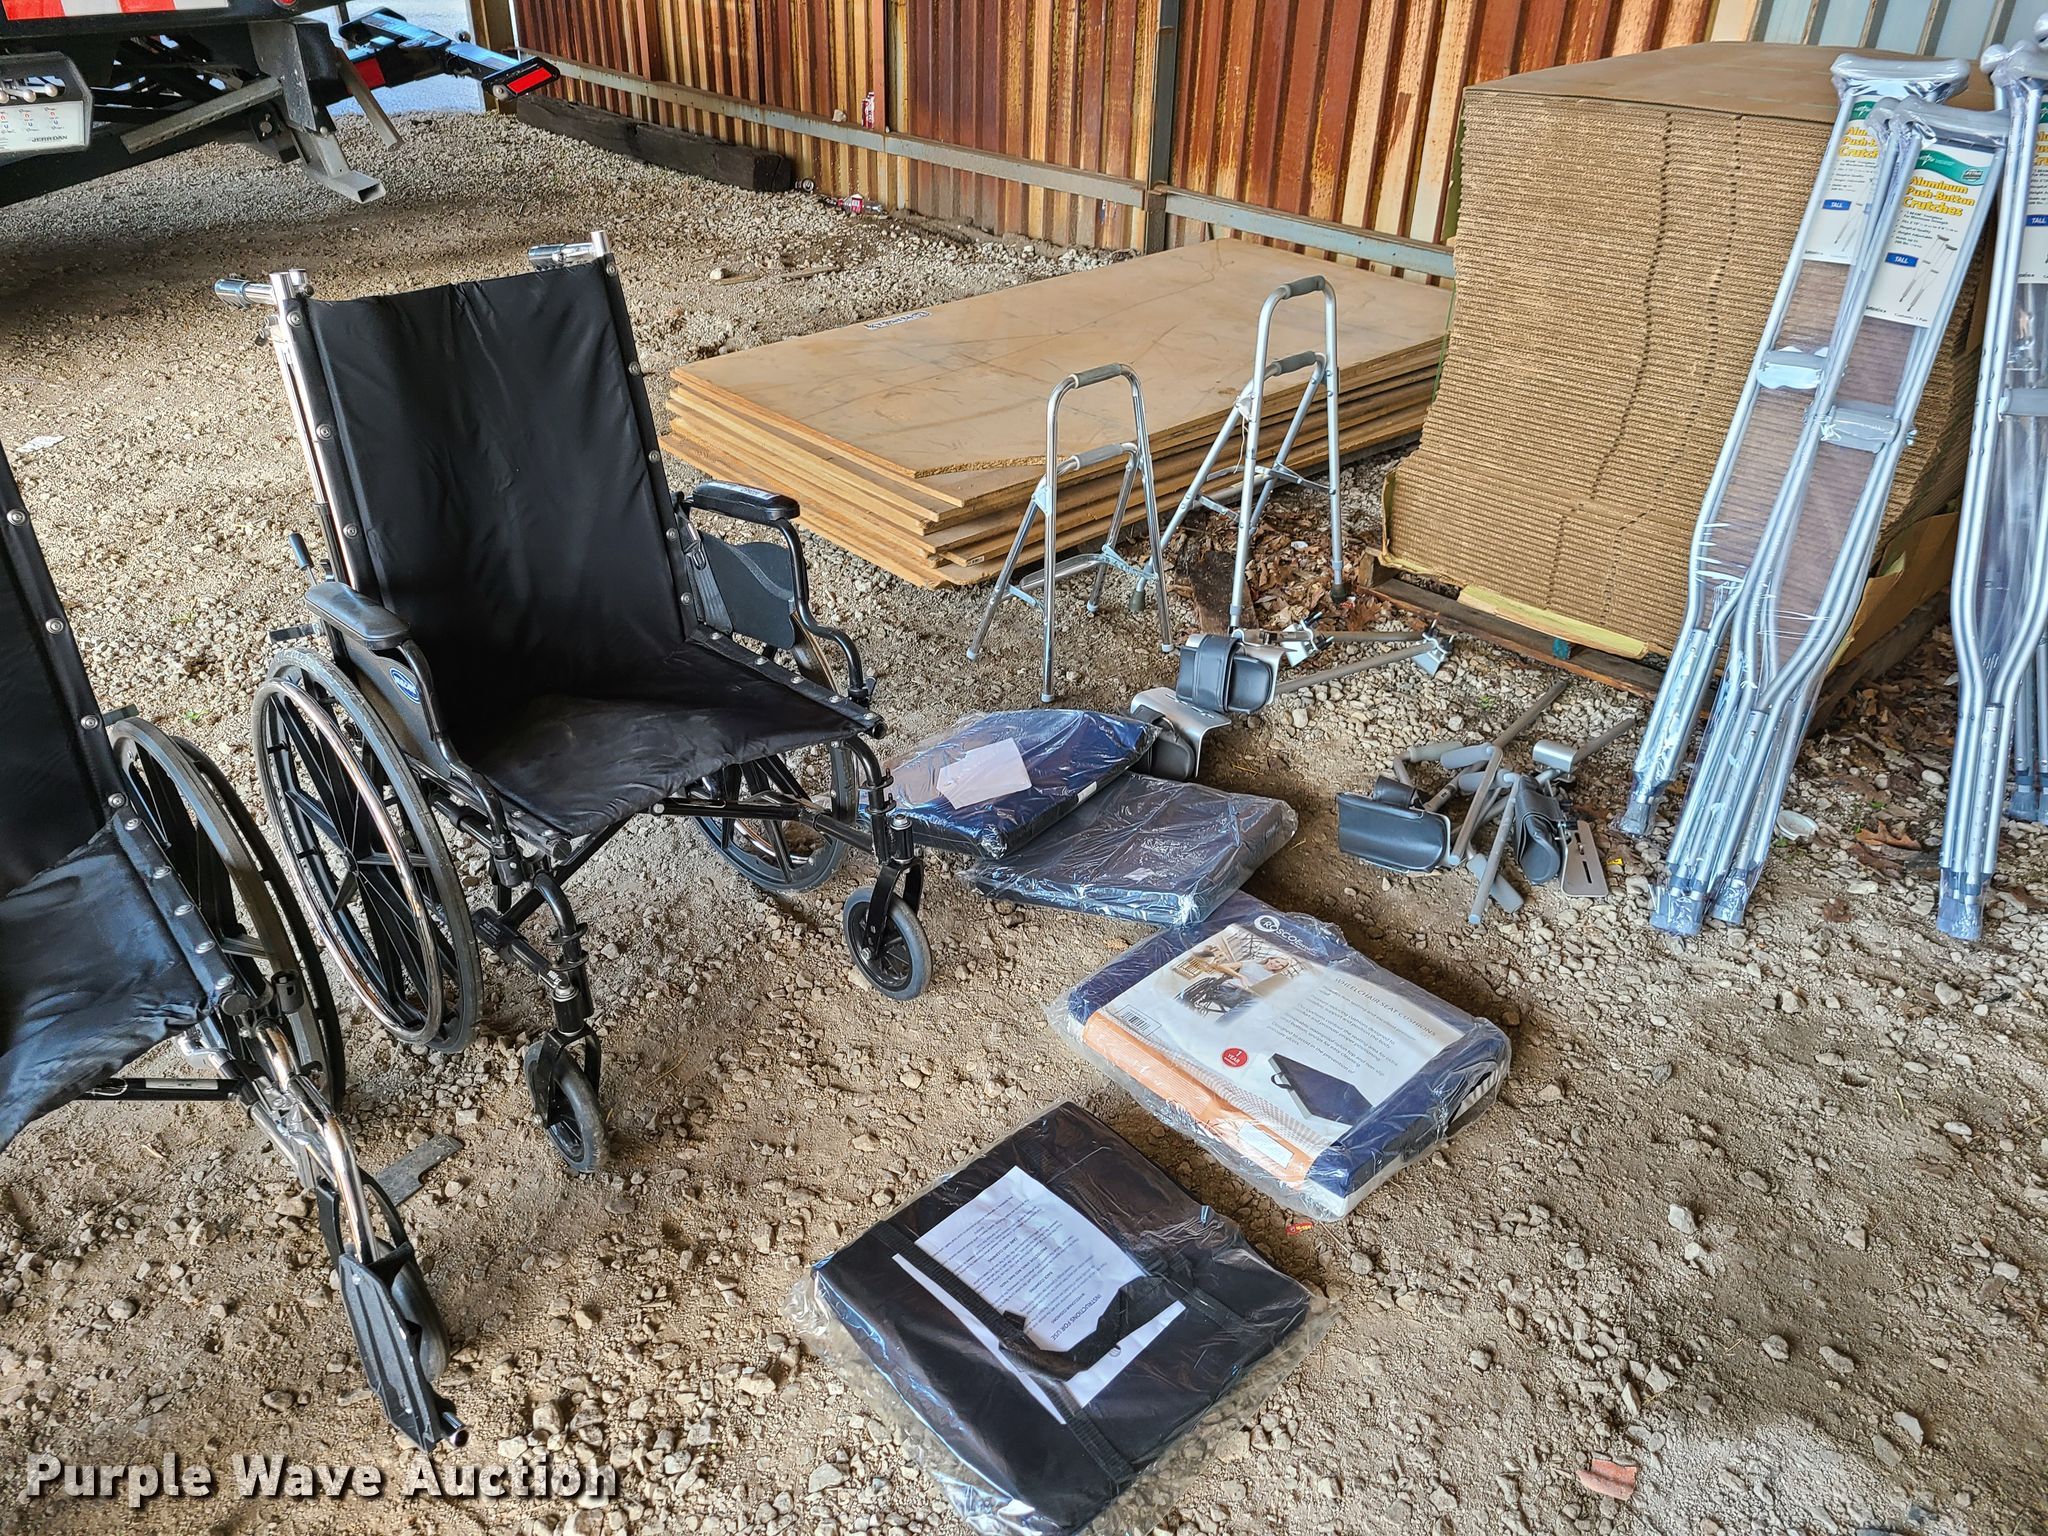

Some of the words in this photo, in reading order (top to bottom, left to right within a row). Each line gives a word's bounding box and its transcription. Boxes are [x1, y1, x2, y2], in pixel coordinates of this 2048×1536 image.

[1909, 176, 1968, 194] Aluminum
[1905, 186, 1976, 206] Push-Button
[1903, 196, 1964, 216] Crutches
[2031, 217, 2047, 225] TALL
[1893, 256, 1910, 265] TALL
[1263, 920, 1304, 944] ROSCOE
[1335, 976, 1380, 1005] WHEELCHAIR
[1379, 1000, 1398, 1014] SEAT
[1397, 1011, 1436, 1036] CUSHIONS
[1068, 1293, 1102, 1323] INSTRUCTIONS
[1049, 1329, 1062, 1341] USE
[1059, 1320, 1072, 1331] FOR
